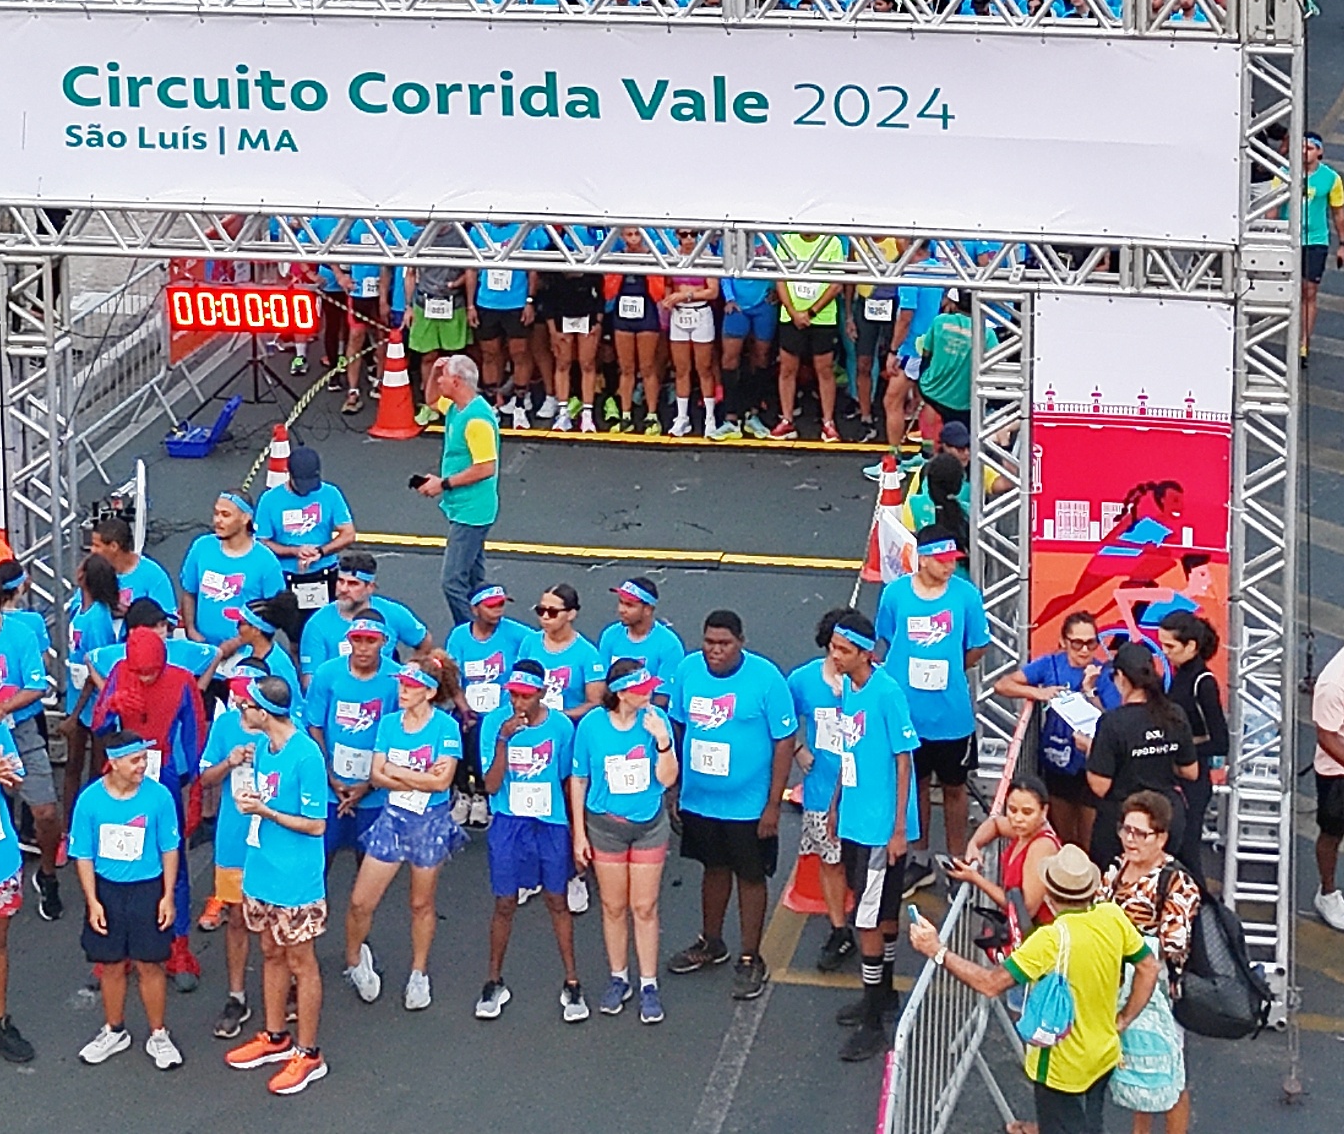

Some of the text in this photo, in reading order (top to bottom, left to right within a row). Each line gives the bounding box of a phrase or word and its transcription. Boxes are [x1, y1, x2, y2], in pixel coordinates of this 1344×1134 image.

[62, 62, 957, 130] Circuito Corrida Vale 2024
[65, 123, 128, 149] São
[139, 124, 208, 151] Luís
[238, 128, 300, 153] MA
[172, 291, 314, 329] 00:00:00
[923, 672, 930, 683] 7
[476, 695, 485, 707] 17
[346, 760, 353, 772] 5
[702, 754, 713, 767] 13
[624, 774, 635, 786] 19
[526, 797, 533, 808] 9
[116, 839, 124, 852] 4
